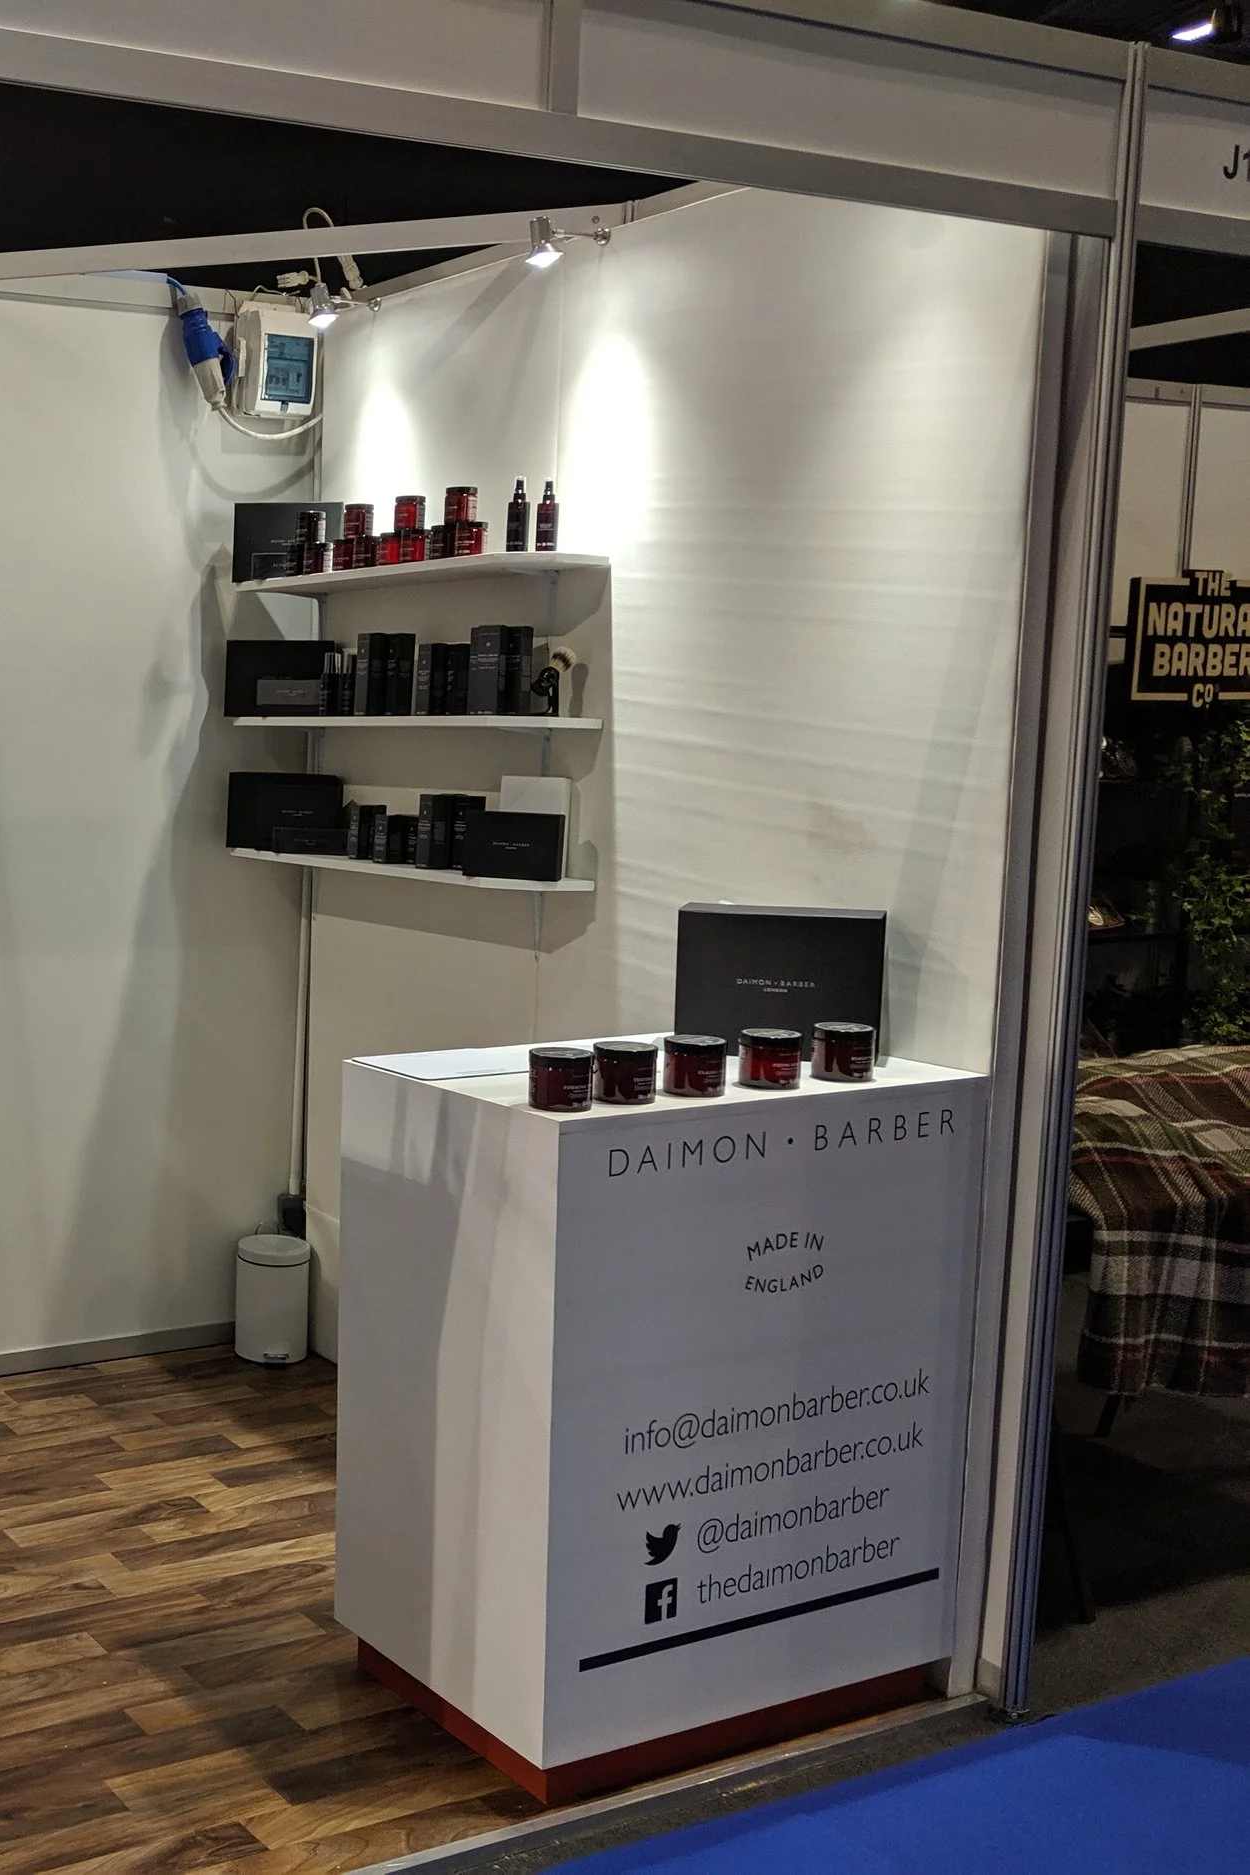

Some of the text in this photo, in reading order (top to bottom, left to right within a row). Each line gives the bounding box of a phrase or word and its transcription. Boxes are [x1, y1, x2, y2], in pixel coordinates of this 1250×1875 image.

[1195, 571, 1232, 597] THE
[1147, 602, 1250, 639] NATURA
[608, 1108, 955, 1177] DAIMON BARBER
[747, 1231, 825, 1262] MADE IN
[745, 1263, 825, 1294] ENGLAND
[624, 1368, 930, 1455] info@daimonbarber.co.uk
[616, 1421, 924, 1512] www.daimonbarber.co.uk
[696, 1485, 890, 1554] @daimonbarber
